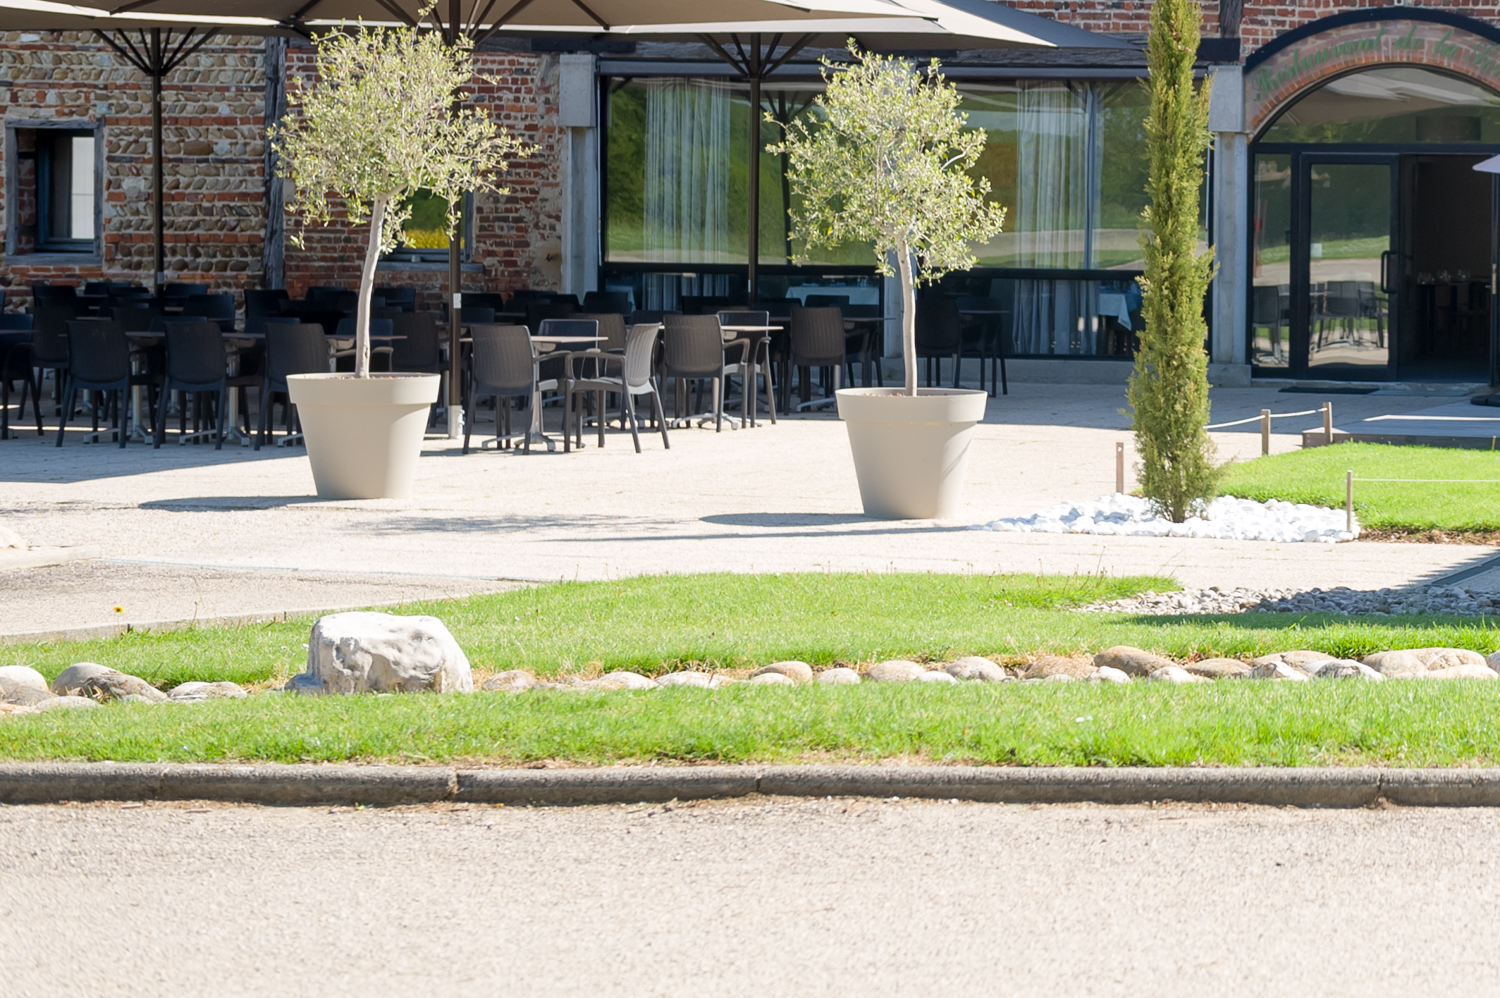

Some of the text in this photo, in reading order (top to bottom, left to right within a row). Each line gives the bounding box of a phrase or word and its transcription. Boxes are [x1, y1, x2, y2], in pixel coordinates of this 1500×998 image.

[1252, 26, 1386, 100] Restaurant
[1395, 24, 1424, 51] de
[1433, 29, 1460, 59] la
